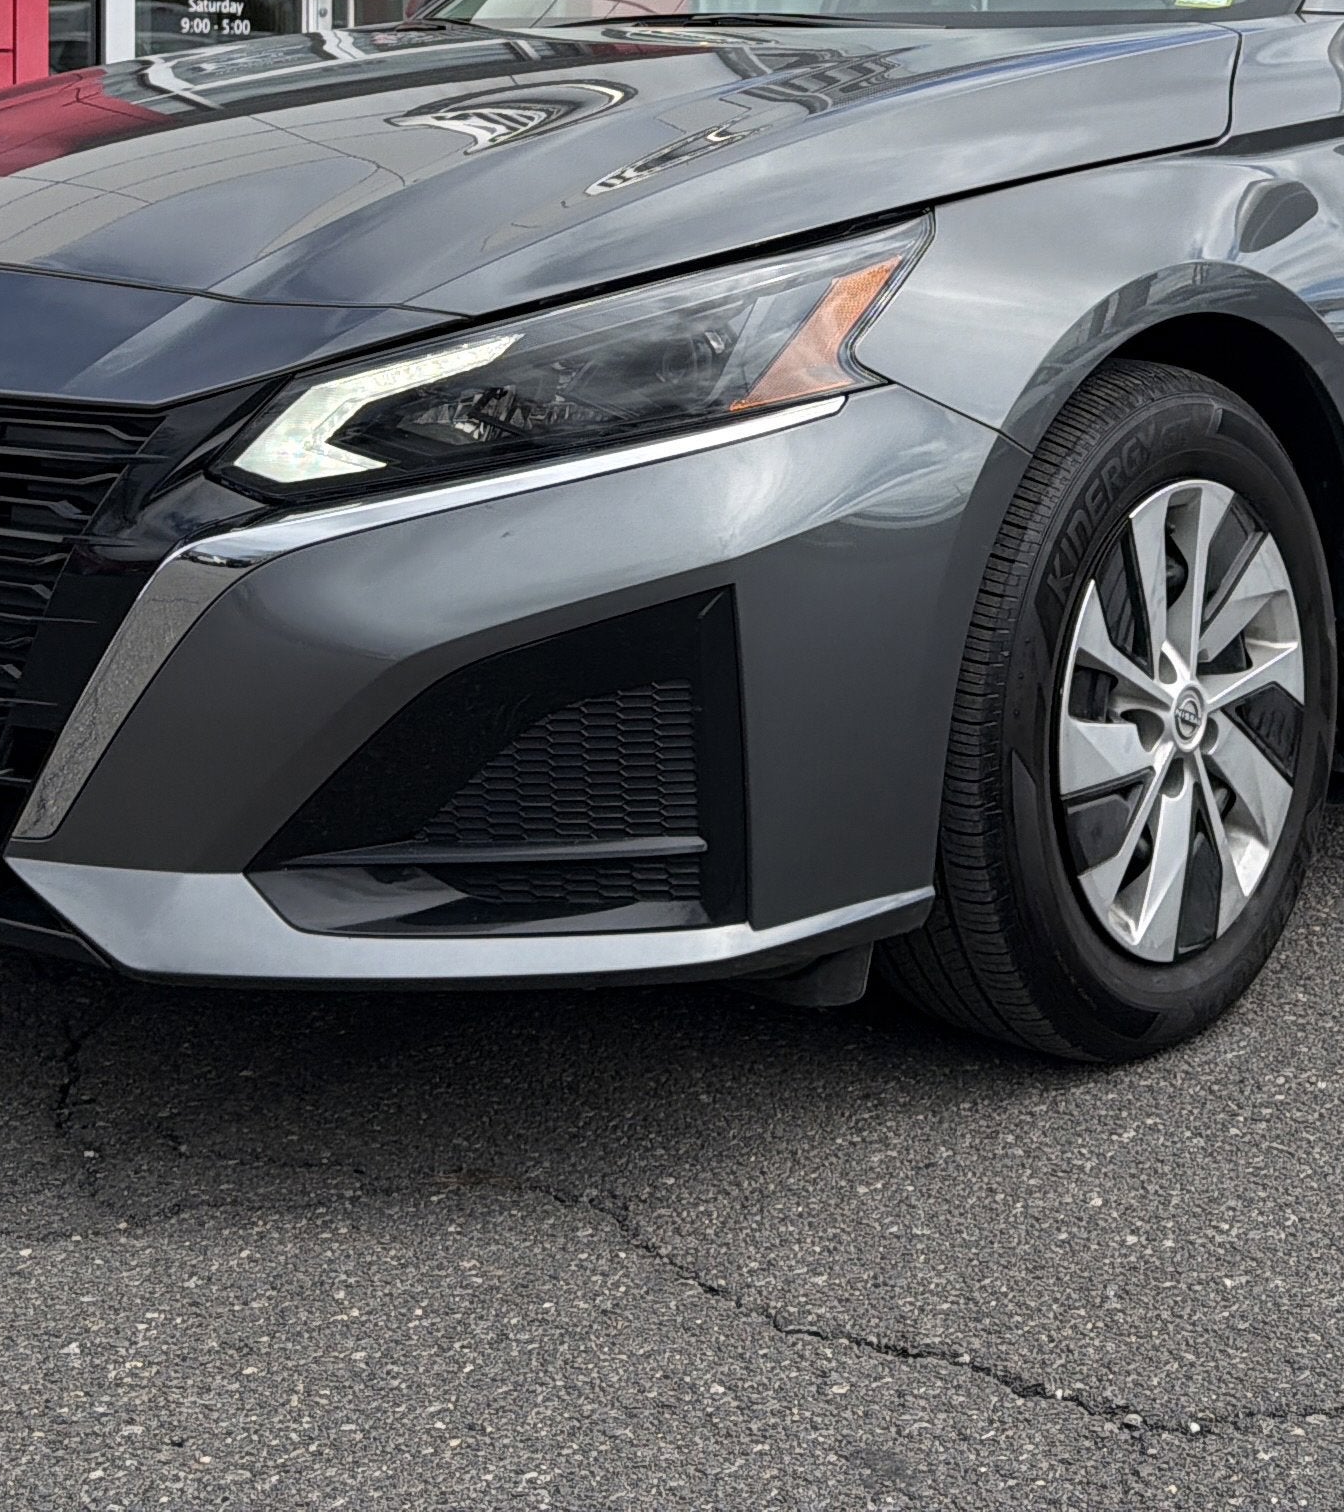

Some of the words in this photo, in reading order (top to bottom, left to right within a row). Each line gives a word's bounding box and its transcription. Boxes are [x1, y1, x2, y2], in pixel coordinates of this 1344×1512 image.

[180, 17, 211, 34] 9:00
[221, 19, 251, 36] 5:00
[1046, 420, 1156, 602] KINERGY
